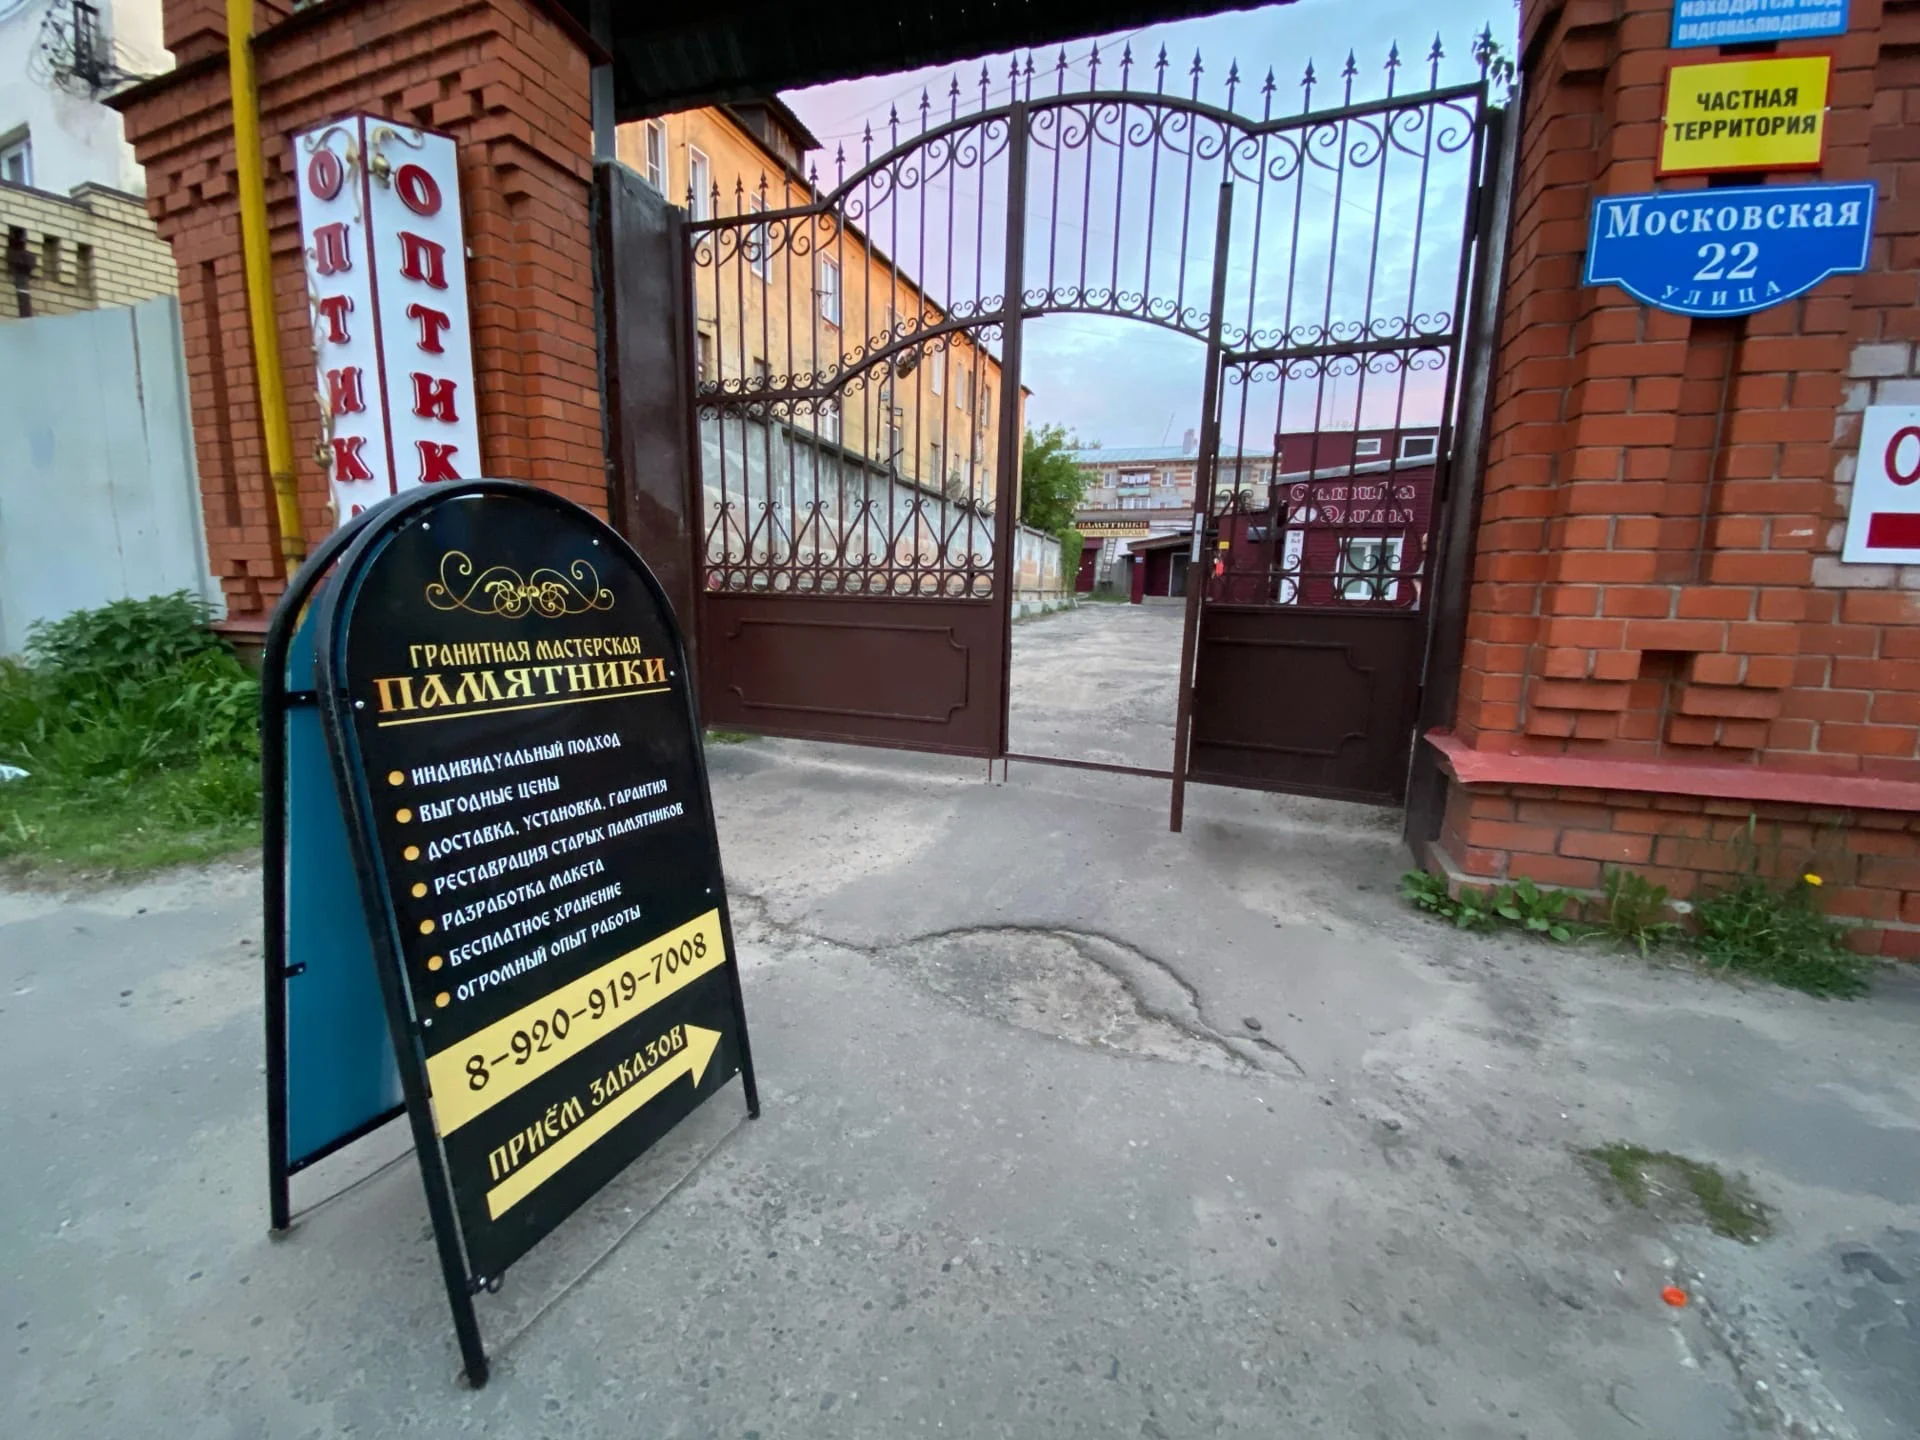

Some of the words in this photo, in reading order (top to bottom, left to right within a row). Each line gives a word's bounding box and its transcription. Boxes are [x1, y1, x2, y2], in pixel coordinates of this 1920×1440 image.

[1678, 11, 1840, 40] ВИДЕОНАБЛЮДЕНИЕМ
[1696, 87, 1798, 112] ЧАСТНАЯ
[1673, 114, 1816, 141] ТЕРРИТОРИЯ
[1605, 200, 1861, 238] Московская
[1693, 241, 1759, 281] 22
[1661, 280, 1781, 306] УЛИЦА
[308, 147, 374, 521] ОПТИК
[409, 641, 531, 668] ГРАНИТНАЯ
[536, 636, 641, 661] МАСТЕРСКАЯ
[373, 658, 667, 712] ПАМЯТНИКИ
[411, 740, 565, 786] ИНДИВИДУАЛЬНЫЙ
[568, 732, 621, 755] ПОДХОД
[419, 785, 513, 823] ВЫГОДНЫЕ
[518, 775, 560, 800] ЦЕНЫ
[609, 779, 668, 808] ГАРАНТИЯ
[433, 844, 549, 895] РЕСТАВРАЦИЯ
[551, 826, 605, 857] СТАРЫХ
[608, 802, 684, 837] ПАМЯТНИКОВ
[442, 880, 546, 931] РАЗРАБОТКА
[549, 859, 604, 890] МАКЕТА
[449, 915, 551, 968] БЕСПЛАТНОЕ
[554, 882, 622, 922] ХРАНЕНИЕ
[456, 946, 547, 1001] ОГРОМНЫЙ
[550, 931, 588, 957] ОПЫТ
[591, 904, 640, 938] РАБОТЫ
[488, 1096, 585, 1181] ПРИЁМ
[590, 1024, 685, 1106] ЗАКАЗОВ
